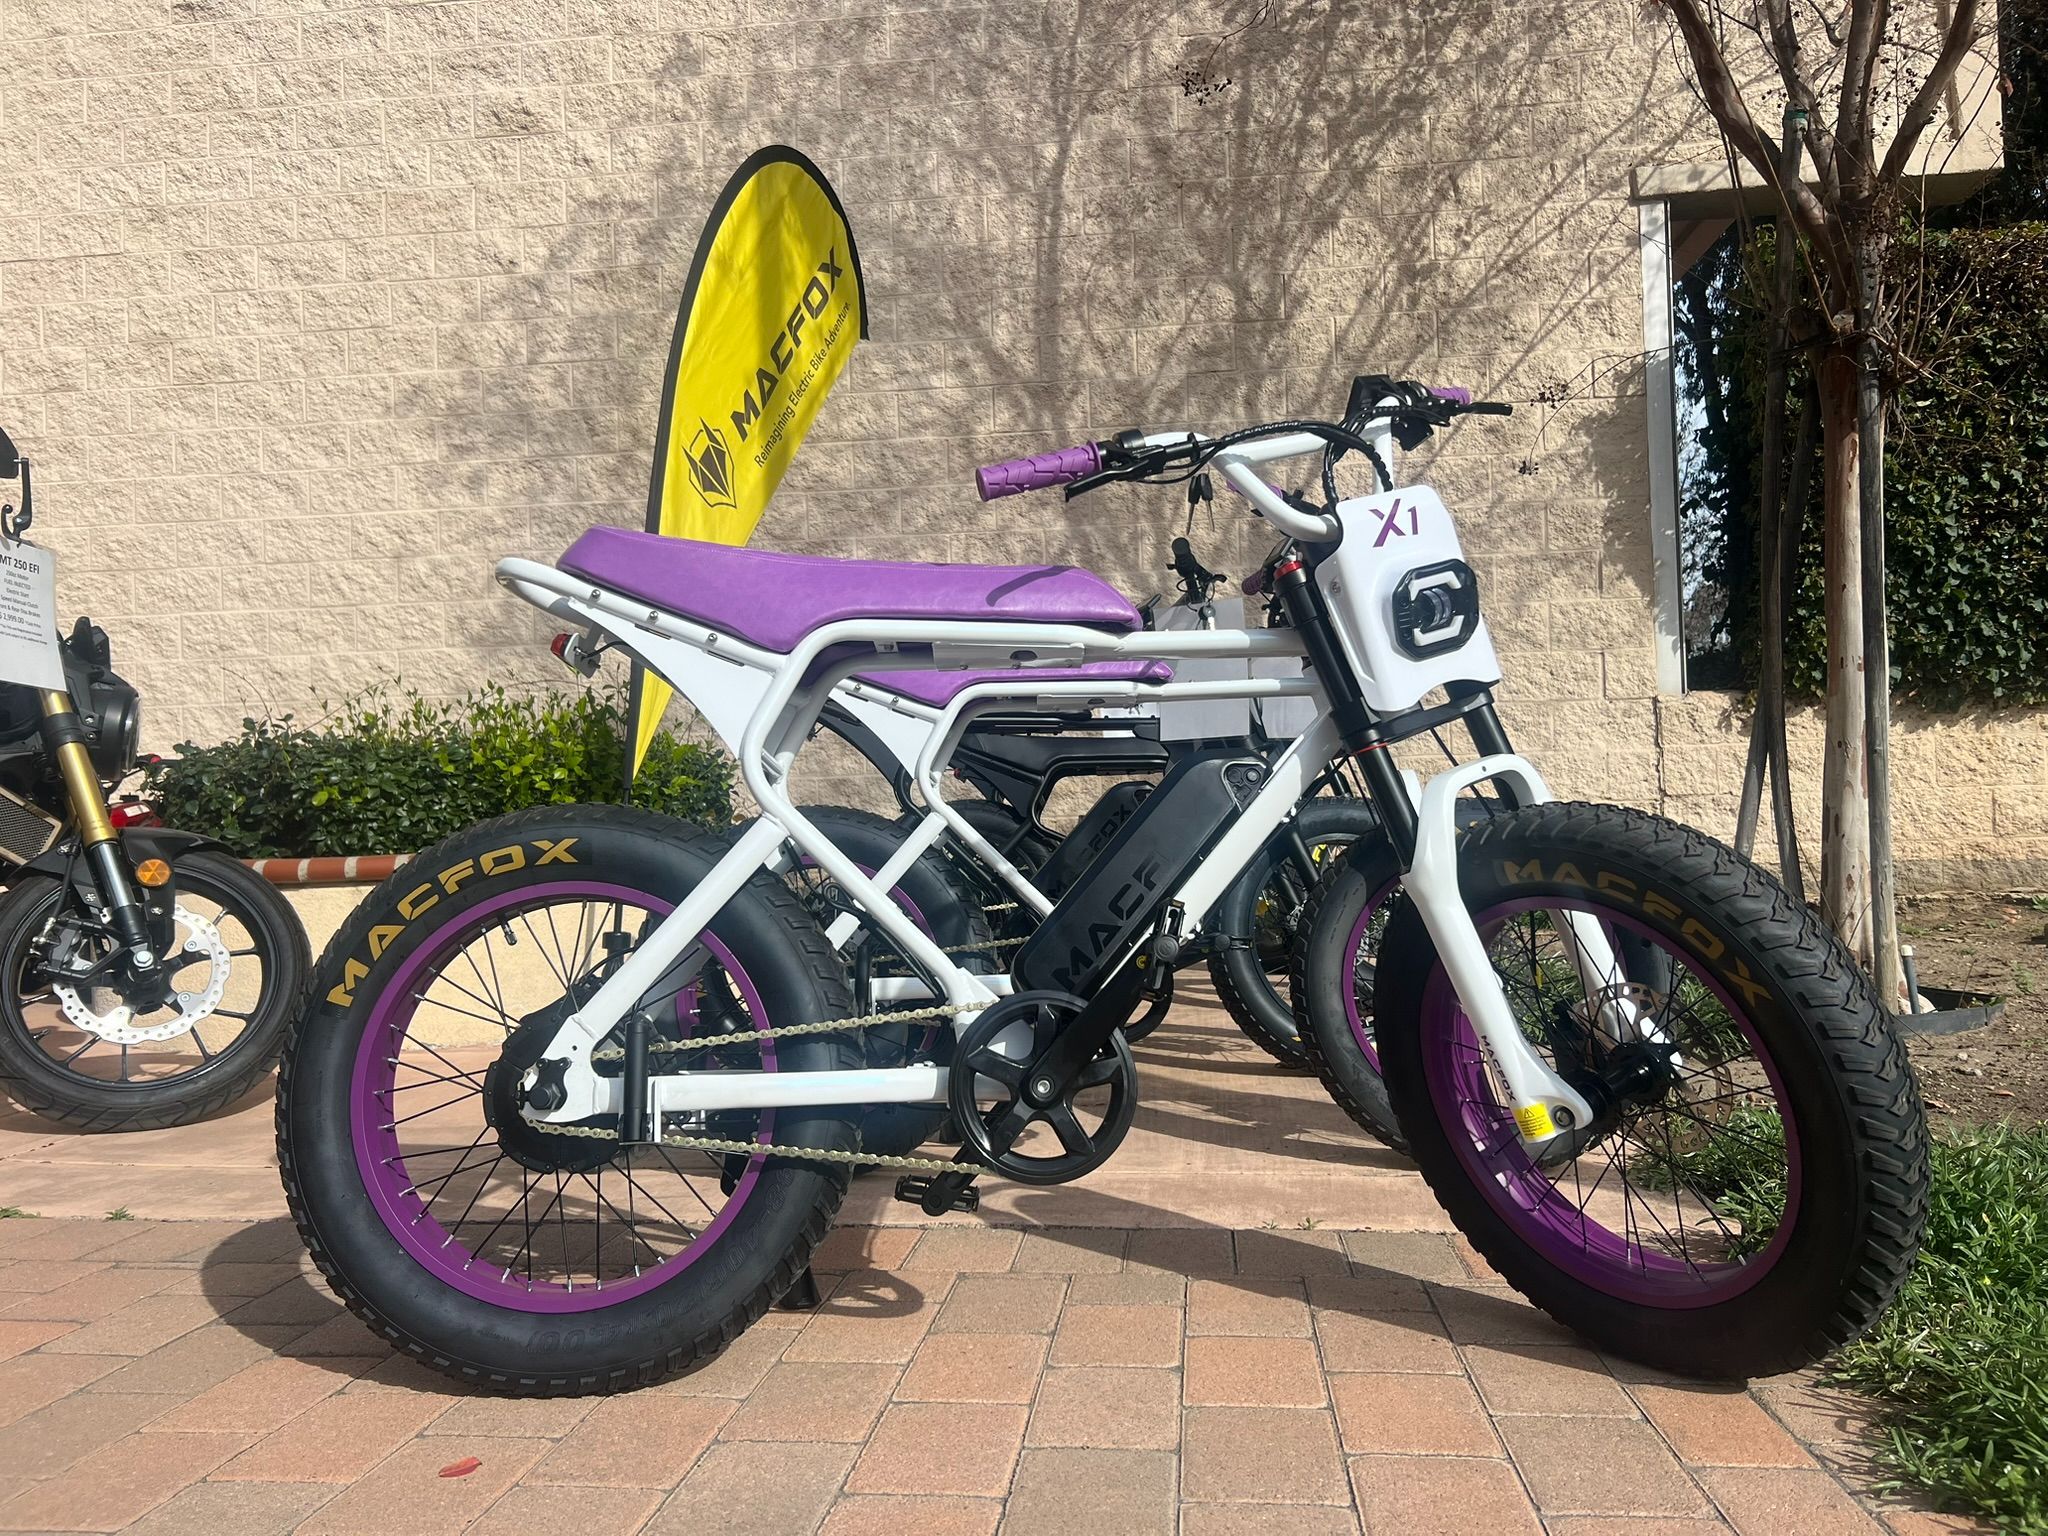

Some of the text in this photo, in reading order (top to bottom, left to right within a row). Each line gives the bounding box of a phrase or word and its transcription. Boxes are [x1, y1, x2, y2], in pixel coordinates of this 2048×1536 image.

[730, 246, 843, 443] MACFOX
[754, 406, 797, 468] Reimagining
[789, 369, 816, 408] Electric
[809, 348, 828, 375] Bike
[14, 558, 28, 571] 250
[29, 562, 40, 575] EFI
[1368, 498, 1419, 547] X1
[326, 838, 579, 1007] MACFOX
[1503, 859, 1773, 1008] MACFOX
[1481, 1035, 1517, 1102] MACFOX
